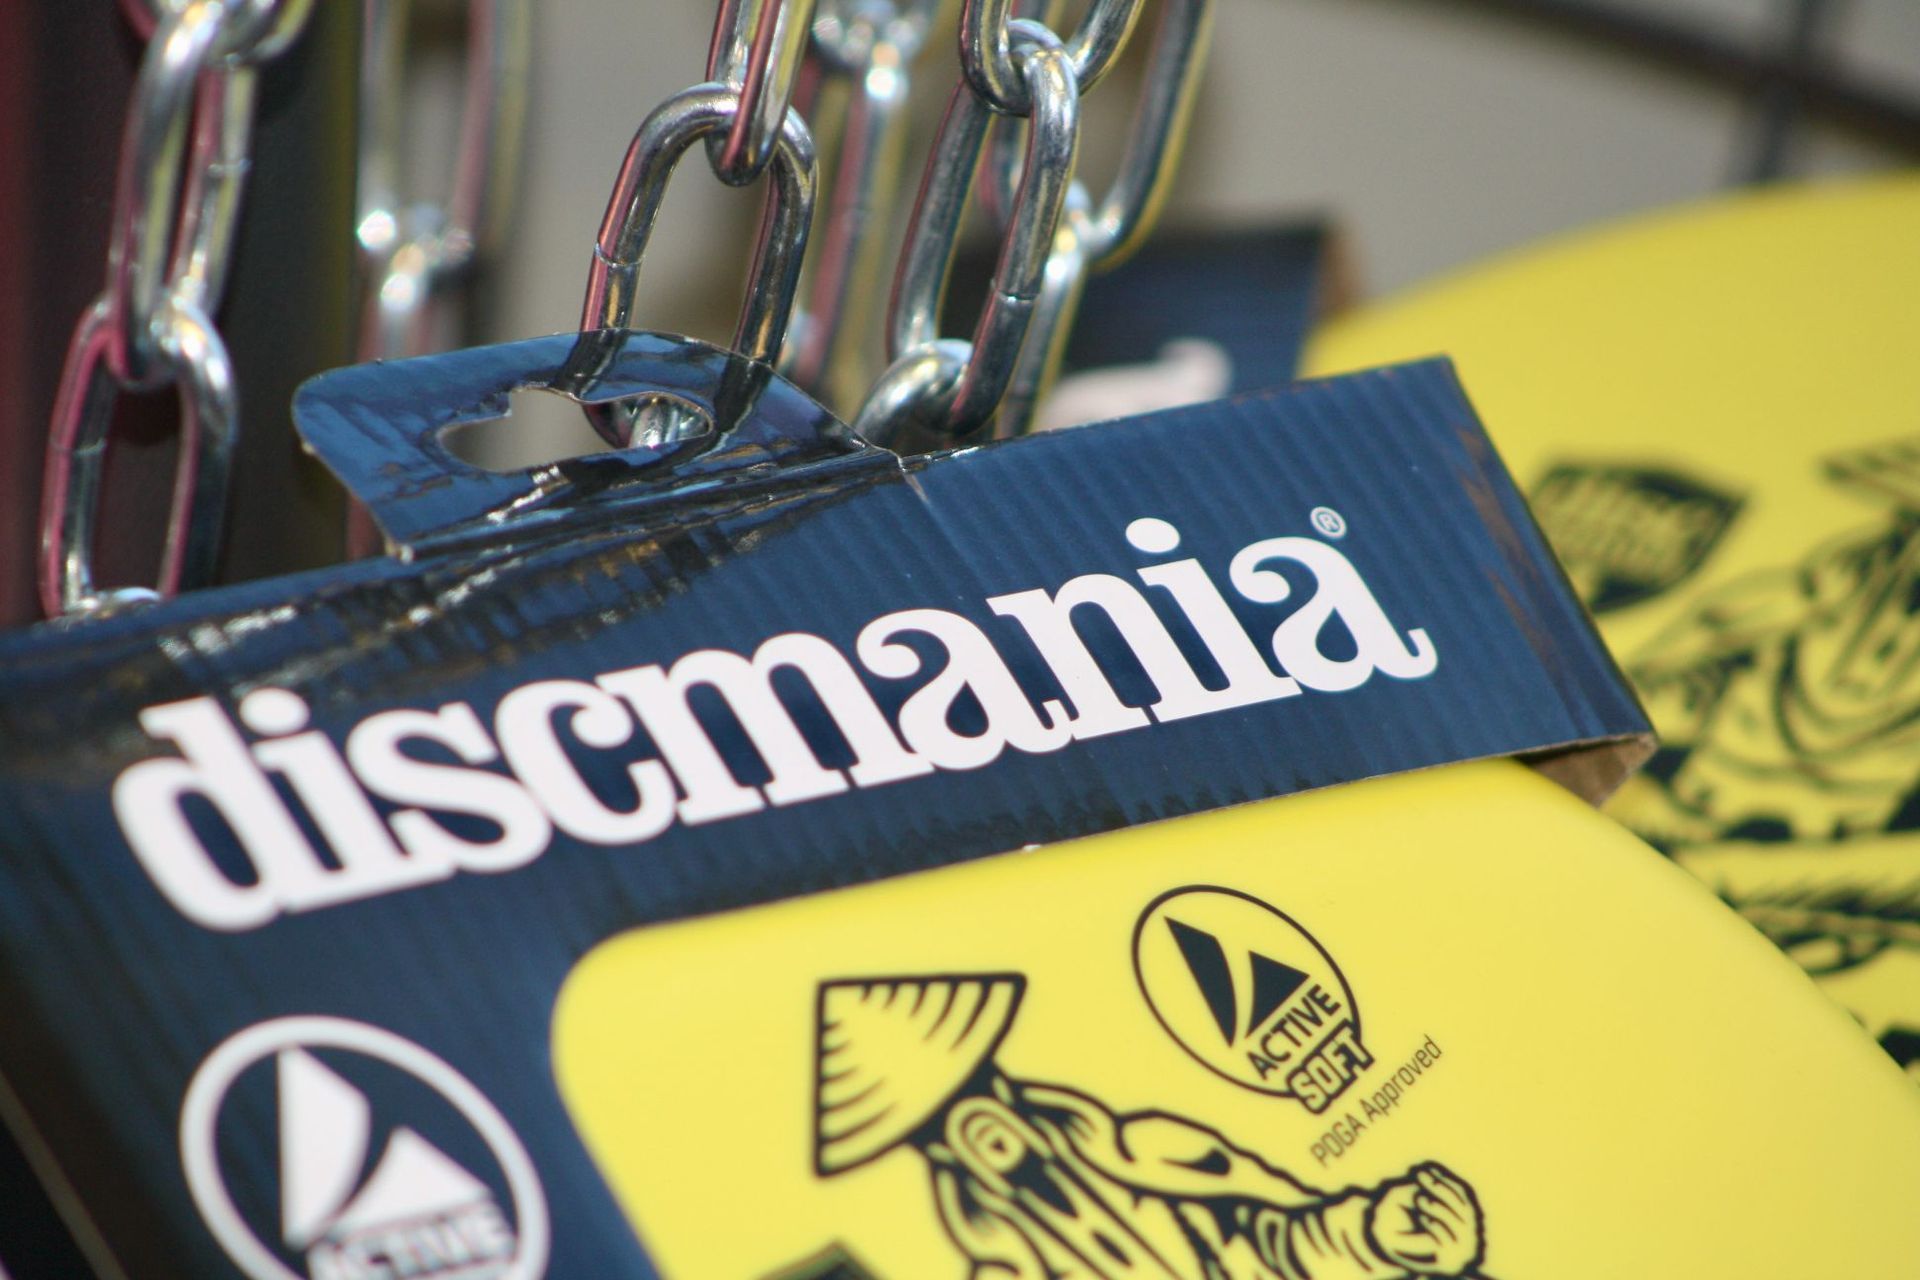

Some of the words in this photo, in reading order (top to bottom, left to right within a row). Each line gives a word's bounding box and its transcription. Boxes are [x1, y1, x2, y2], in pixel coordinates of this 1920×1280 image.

[1246, 985, 1341, 1080] ACTIVE
[1287, 1018, 1375, 1114] SOFT
[1310, 1114, 1367, 1168] PDGA
[1360, 1034, 1442, 1122] Approved
